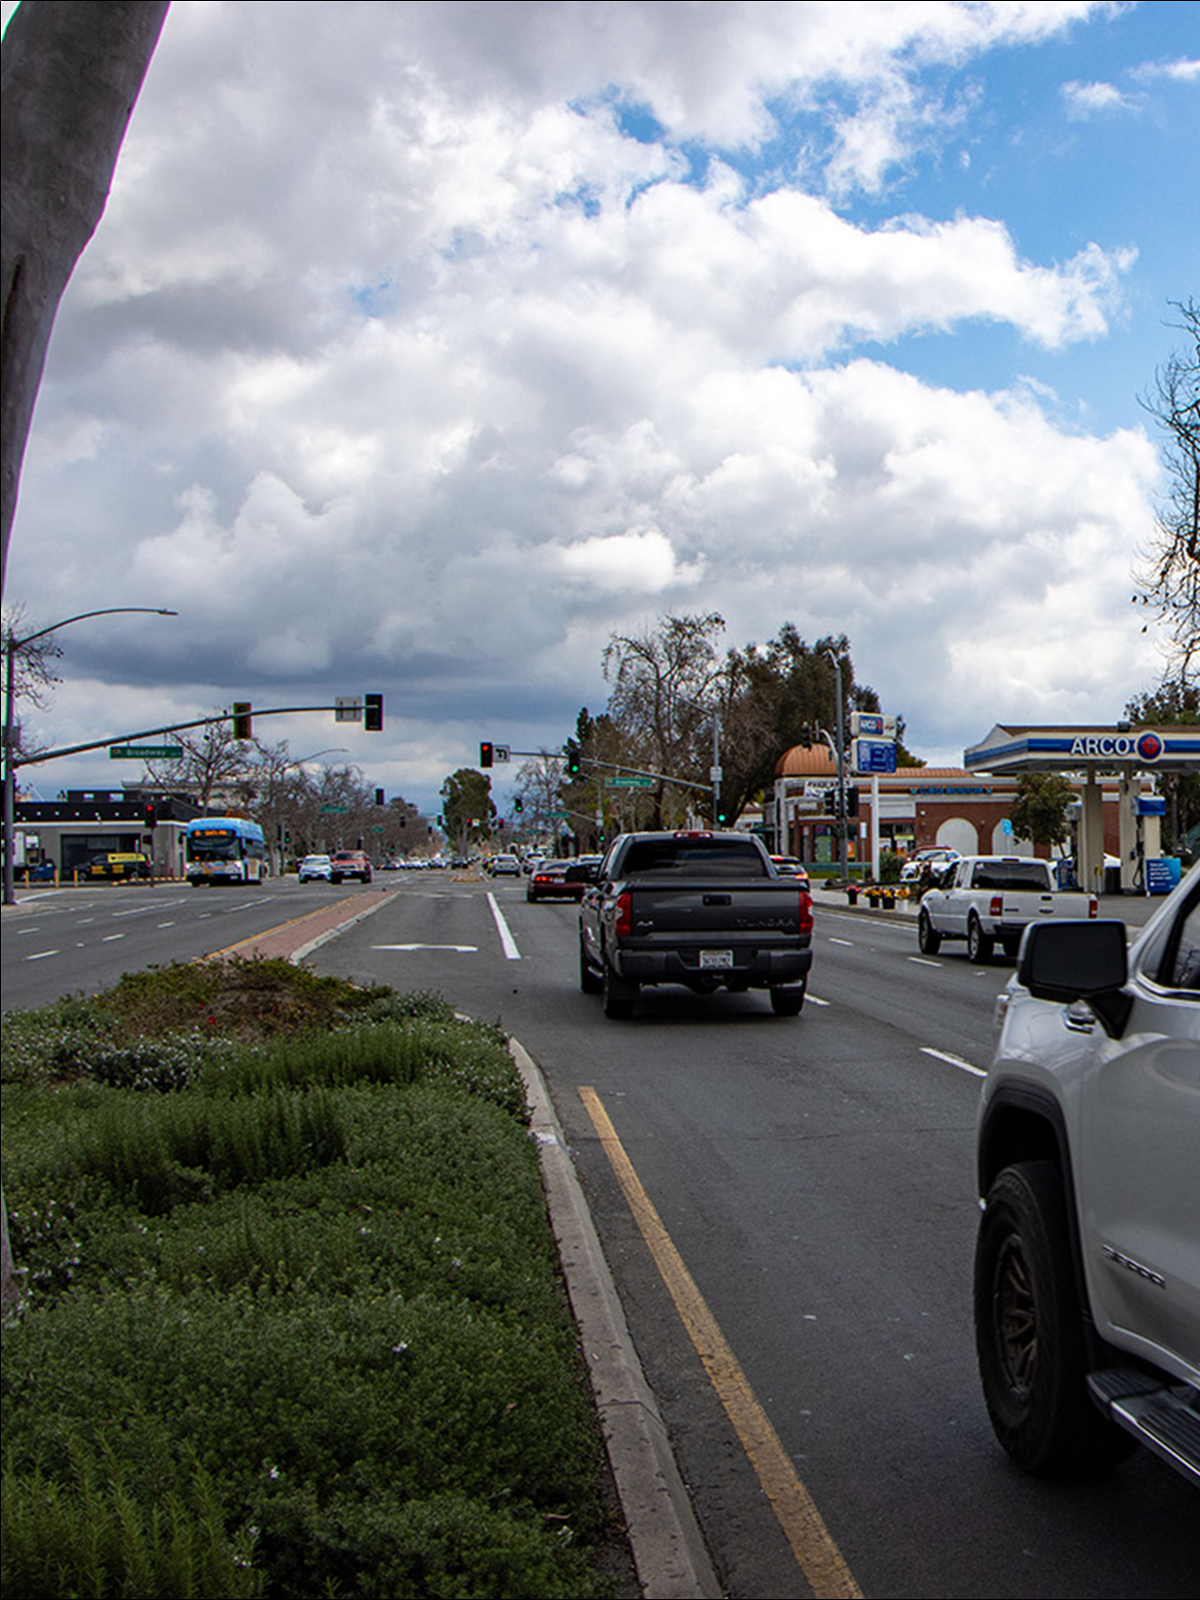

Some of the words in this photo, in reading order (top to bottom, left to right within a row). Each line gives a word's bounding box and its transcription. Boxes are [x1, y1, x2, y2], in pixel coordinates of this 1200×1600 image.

[861, 719, 876, 730] ARCO
[1070, 736, 1130, 756] ARCO
[126, 748, 167, 758] Broadway
